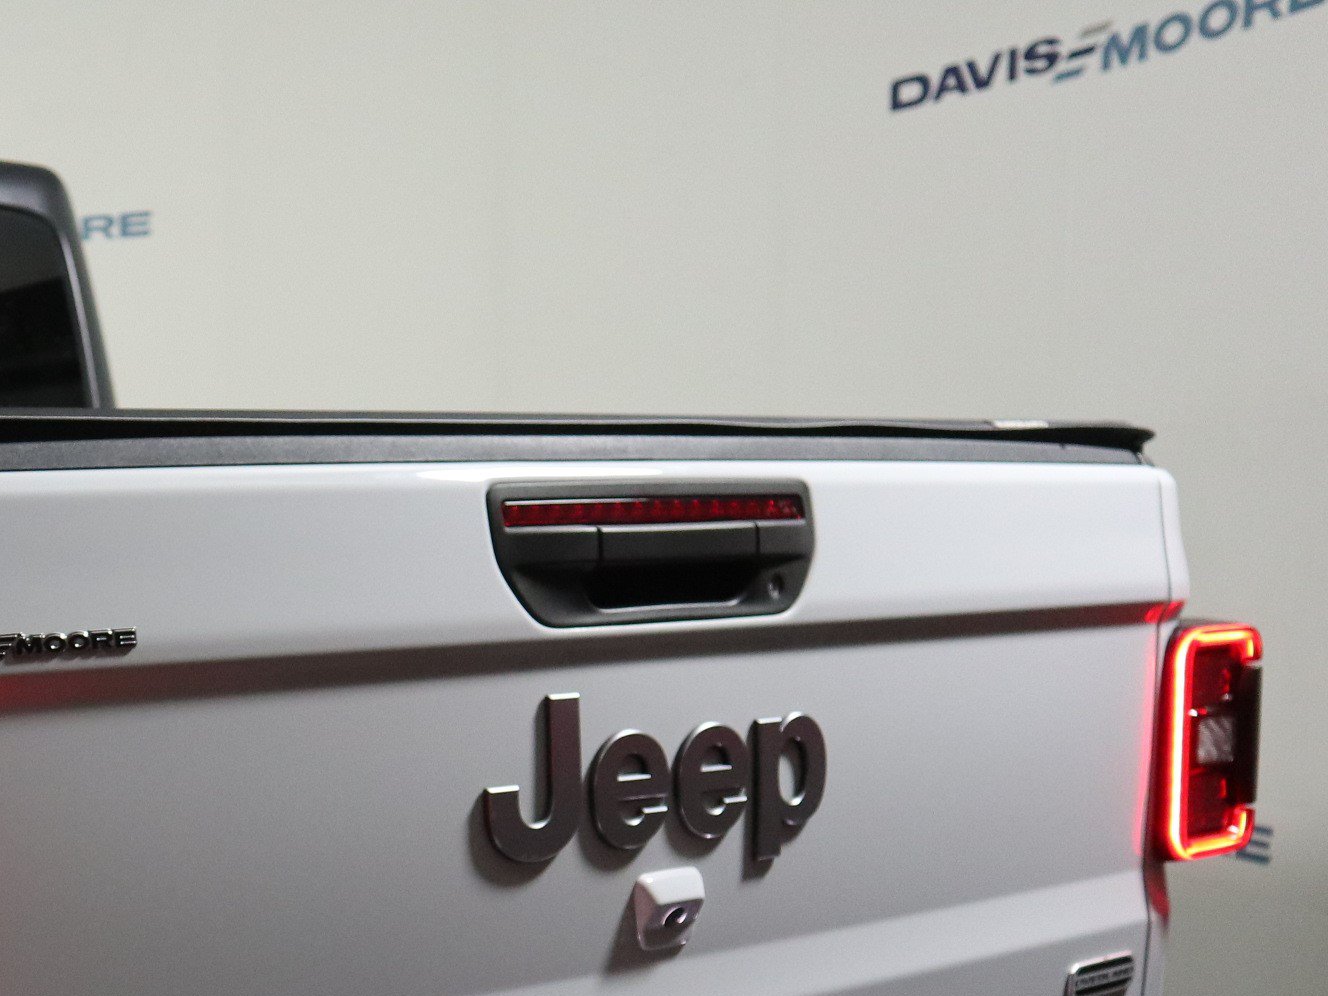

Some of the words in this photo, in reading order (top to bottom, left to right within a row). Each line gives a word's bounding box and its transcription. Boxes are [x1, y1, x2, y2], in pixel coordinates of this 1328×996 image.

[889, 37, 1062, 112] DAVIS
[15, 626, 138, 655] MOORE
[483, 692, 827, 863] Jeep
